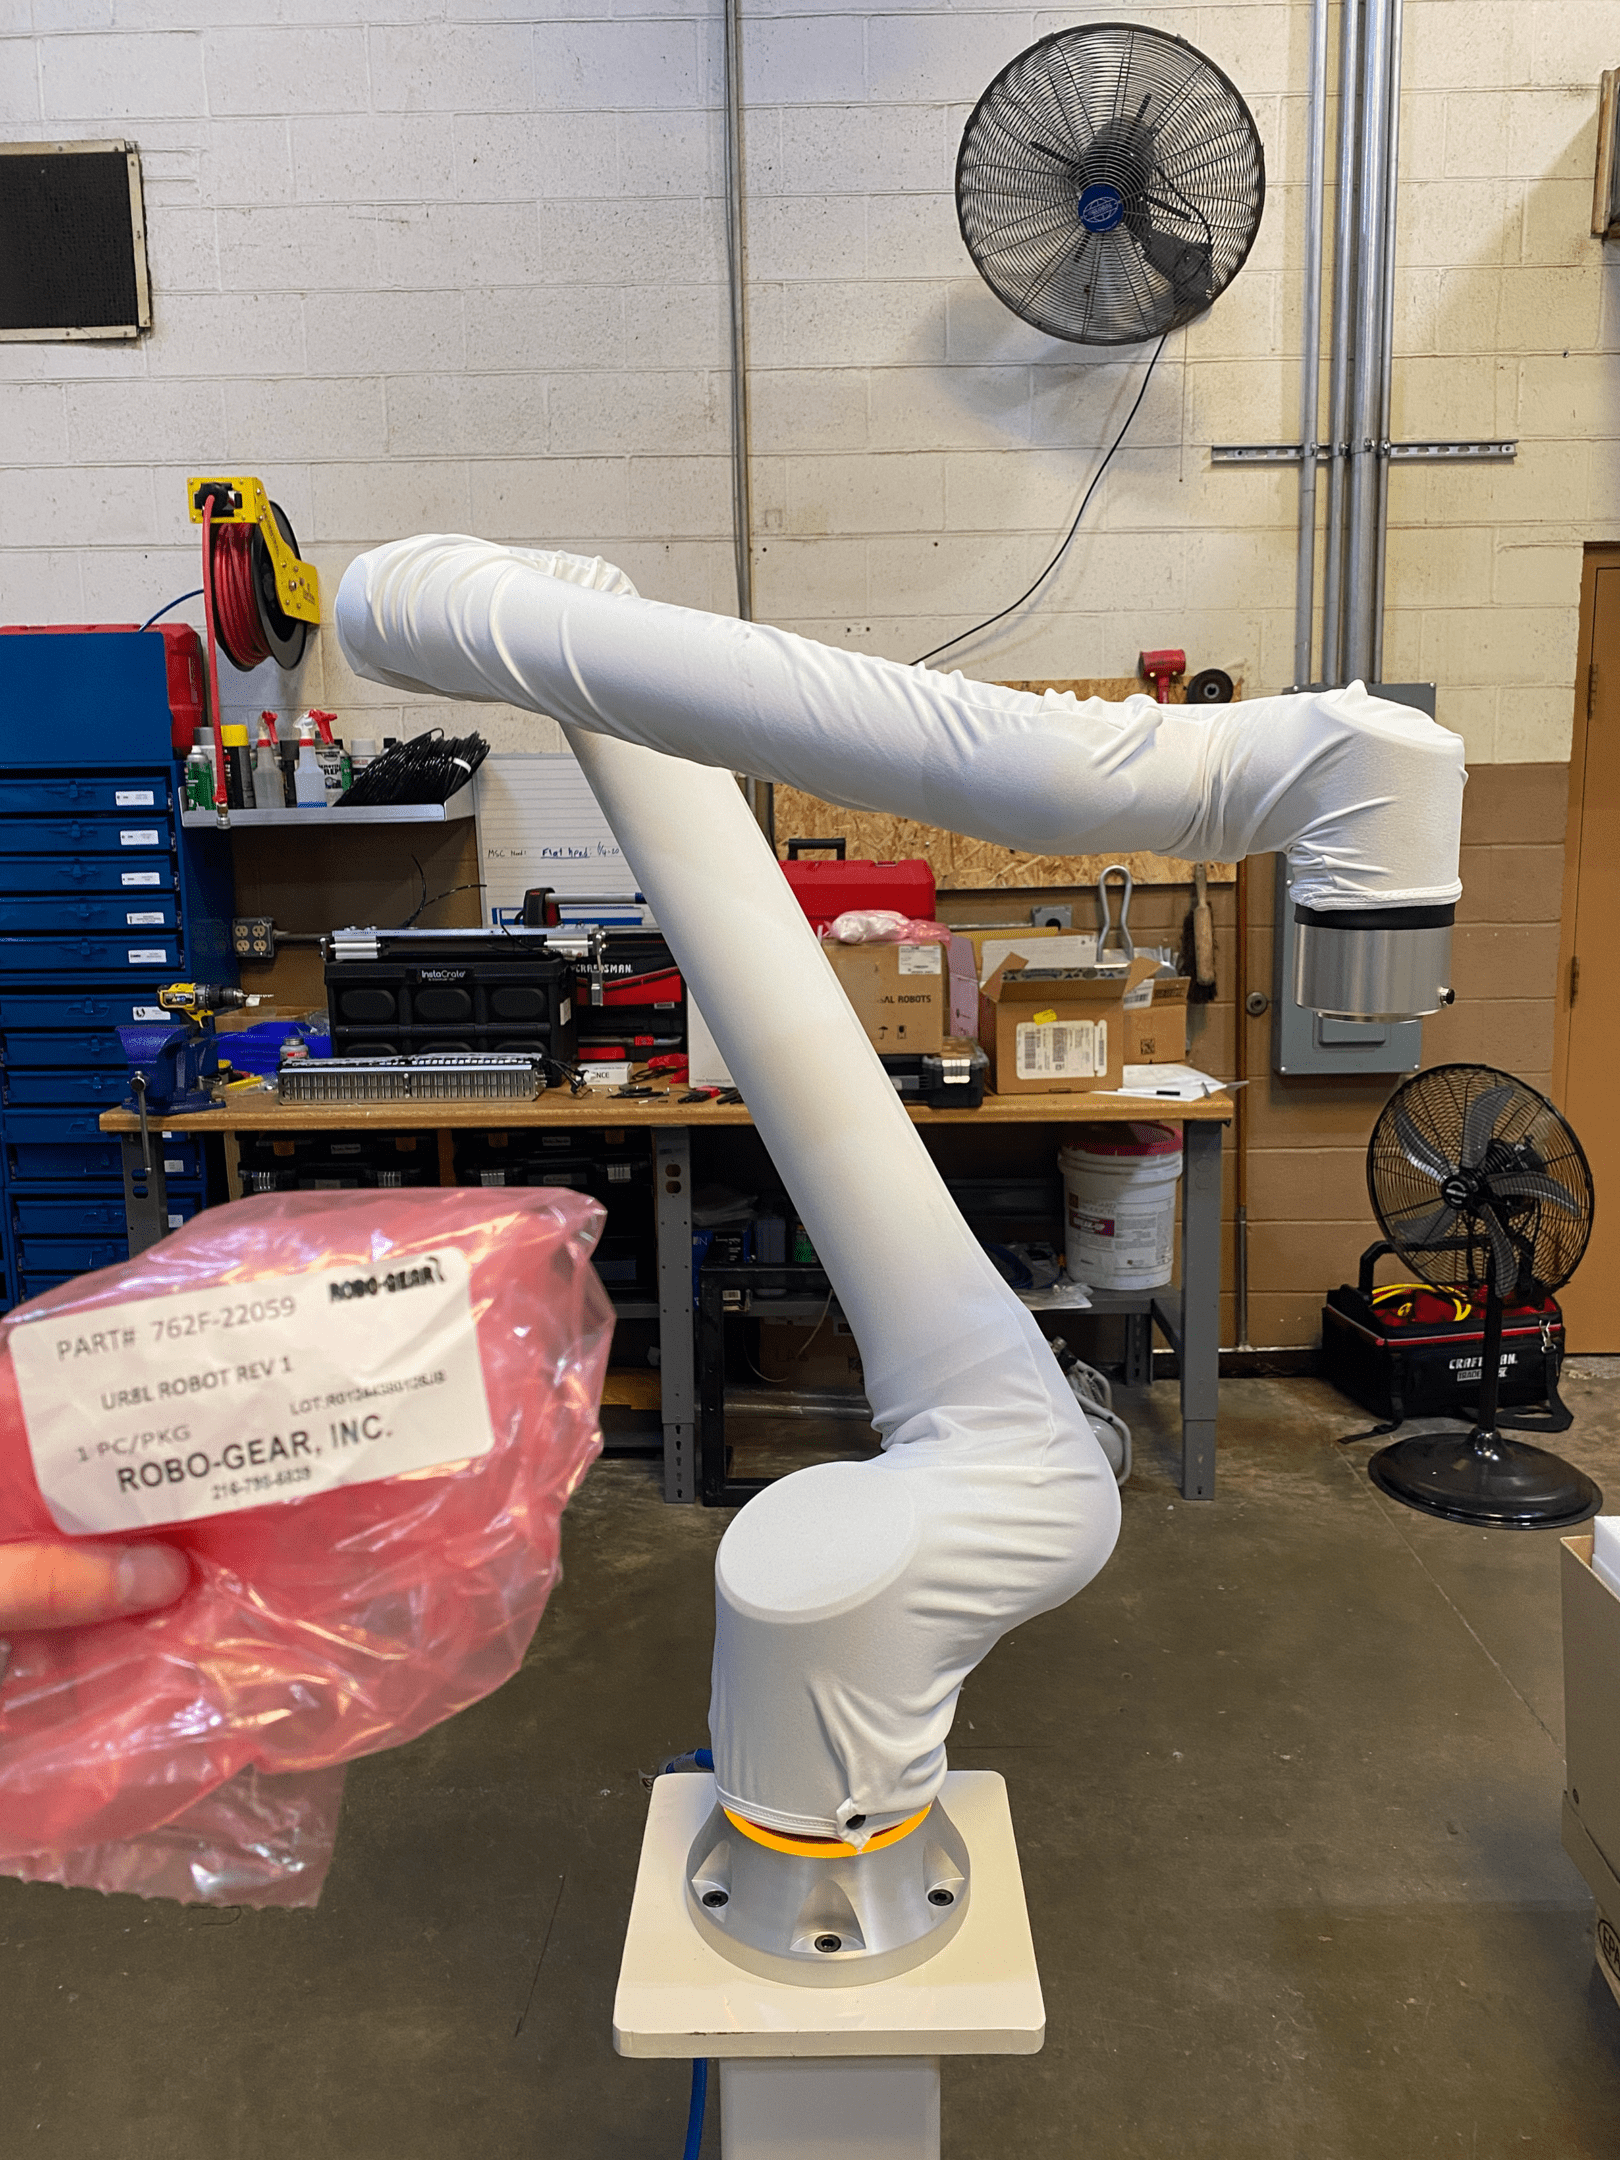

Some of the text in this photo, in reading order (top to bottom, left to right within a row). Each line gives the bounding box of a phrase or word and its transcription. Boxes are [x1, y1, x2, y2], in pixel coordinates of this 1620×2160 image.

[487, 849, 505, 858] MSC
[542, 847, 562, 857] Flat
[421, 969, 466, 979] InstaCrate
[575, 963, 632, 974] CRAFSMAN
[897, 994, 932, 1004] ROBOTS
[56, 1296, 297, 1361] PART# 762F-22059
[1448, 1353, 1516, 1370] CRAFTAN
[158, 1368, 230, 1399] ROBOT
[236, 1358, 275, 1384] REV
[281, 1355, 293, 1374] 1
[77, 1424, 192, 1463] 1 PC/PKG
[116, 1414, 393, 1493] ROBO-GEAR, INC.
